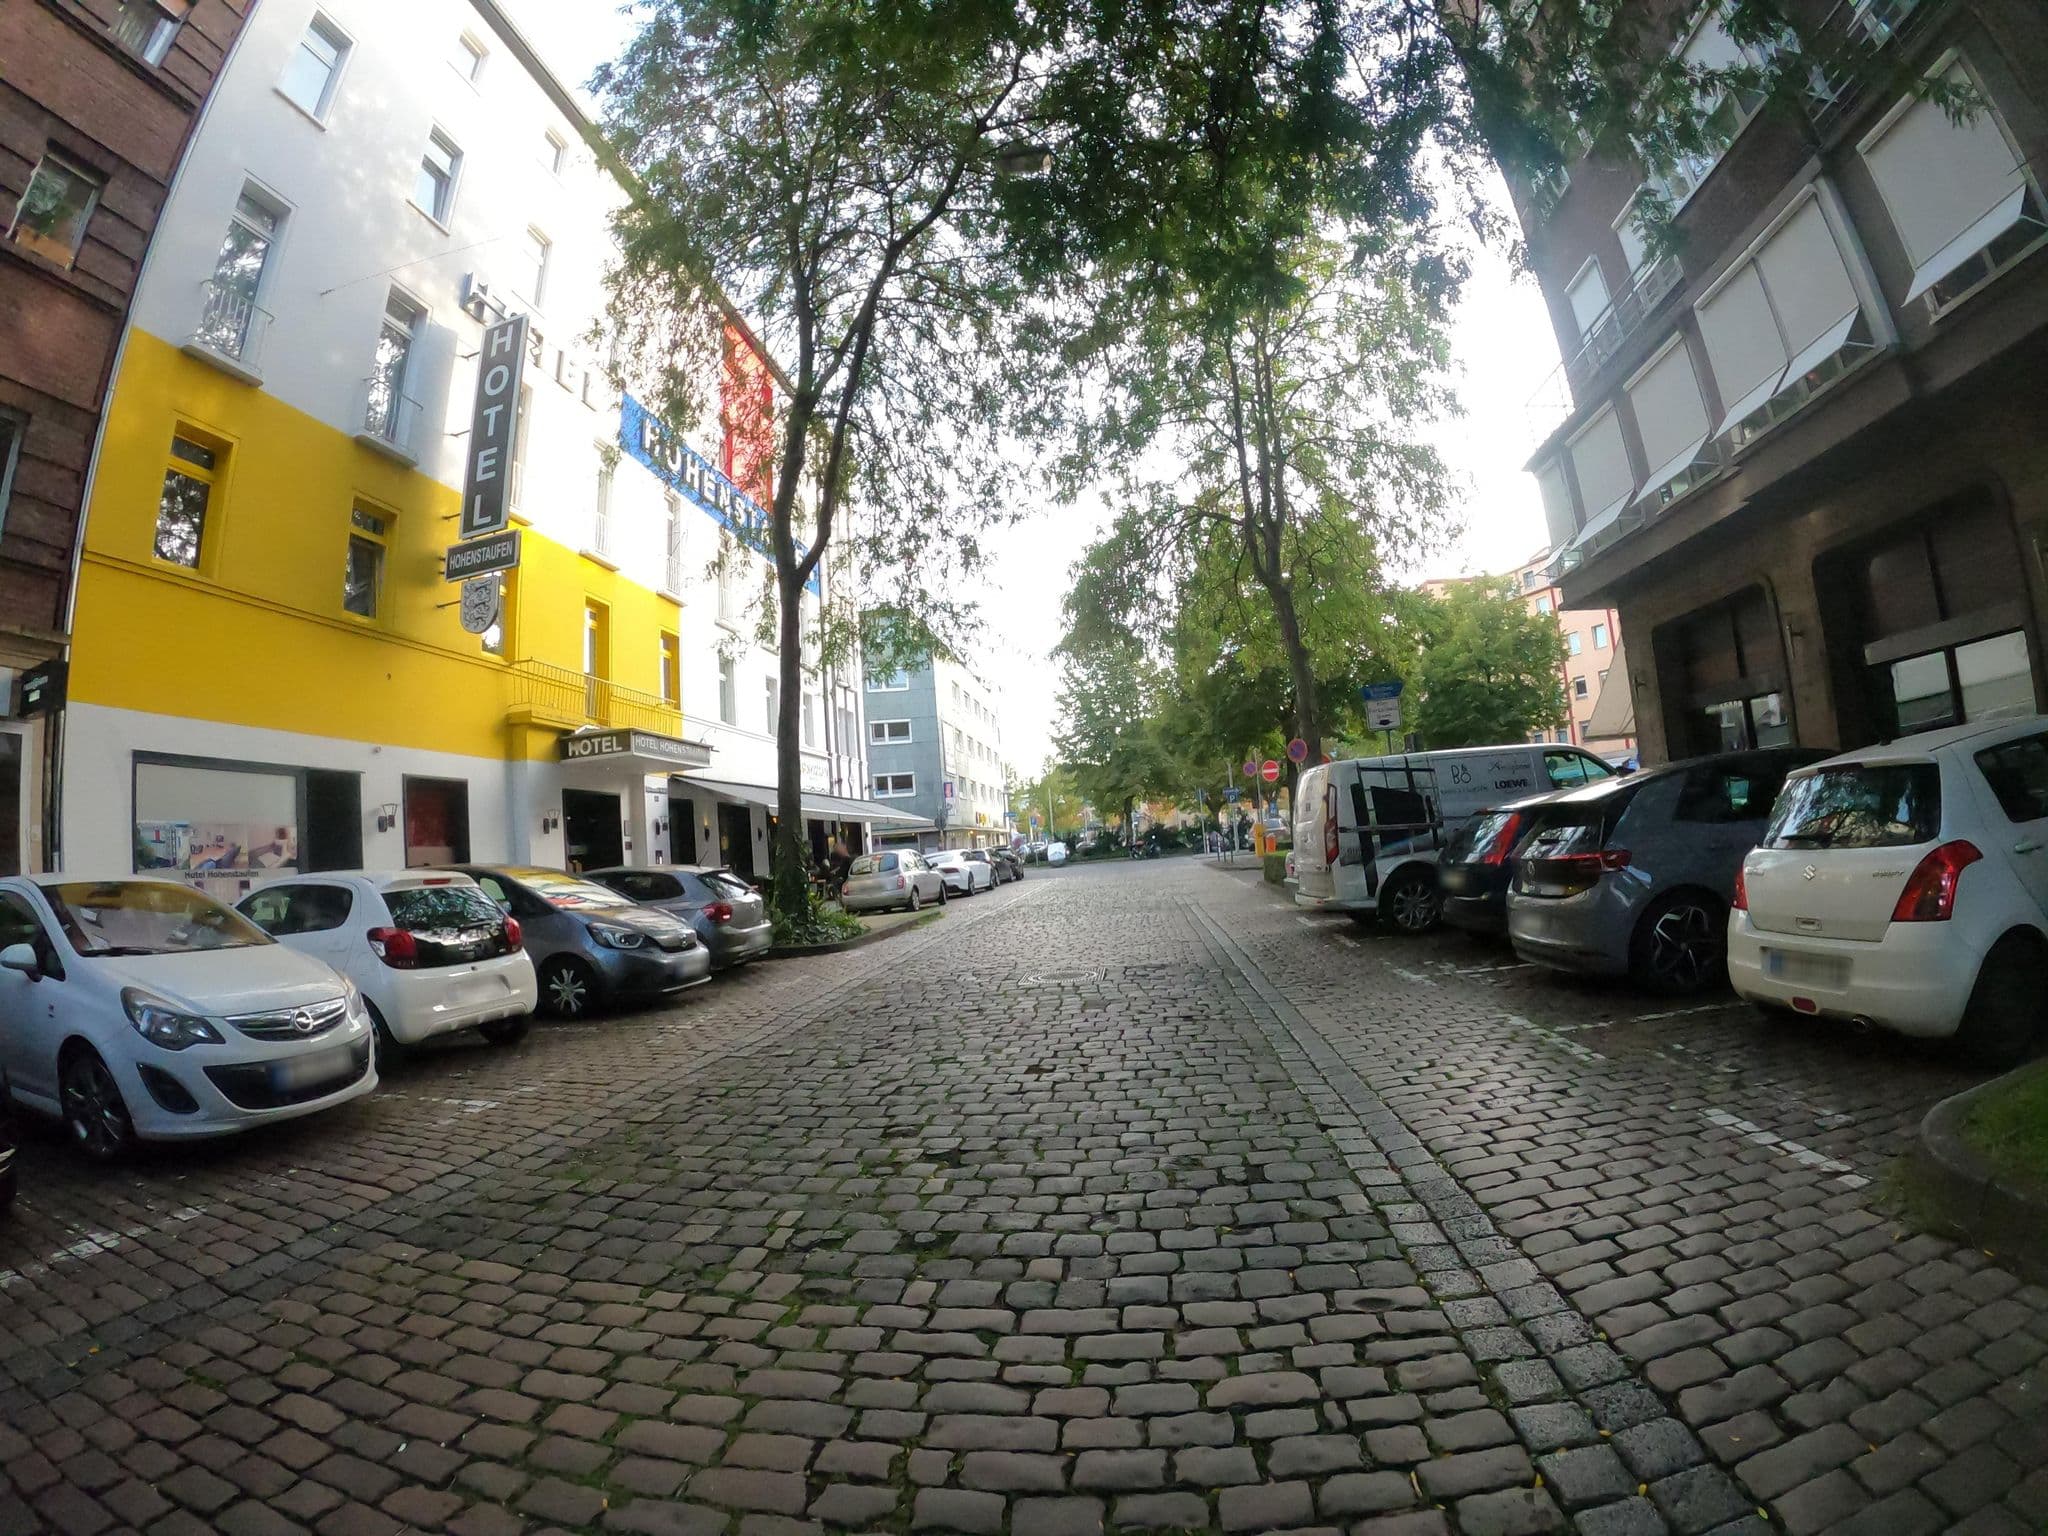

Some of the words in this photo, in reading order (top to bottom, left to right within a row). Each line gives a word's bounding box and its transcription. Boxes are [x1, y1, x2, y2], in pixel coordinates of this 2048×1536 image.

[473, 324, 514, 526] HOTEL
[449, 540, 513, 571] HOHENSTAUFEN
[568, 735, 622, 757] HOTEL
[635, 735, 658, 750] HOTEL
